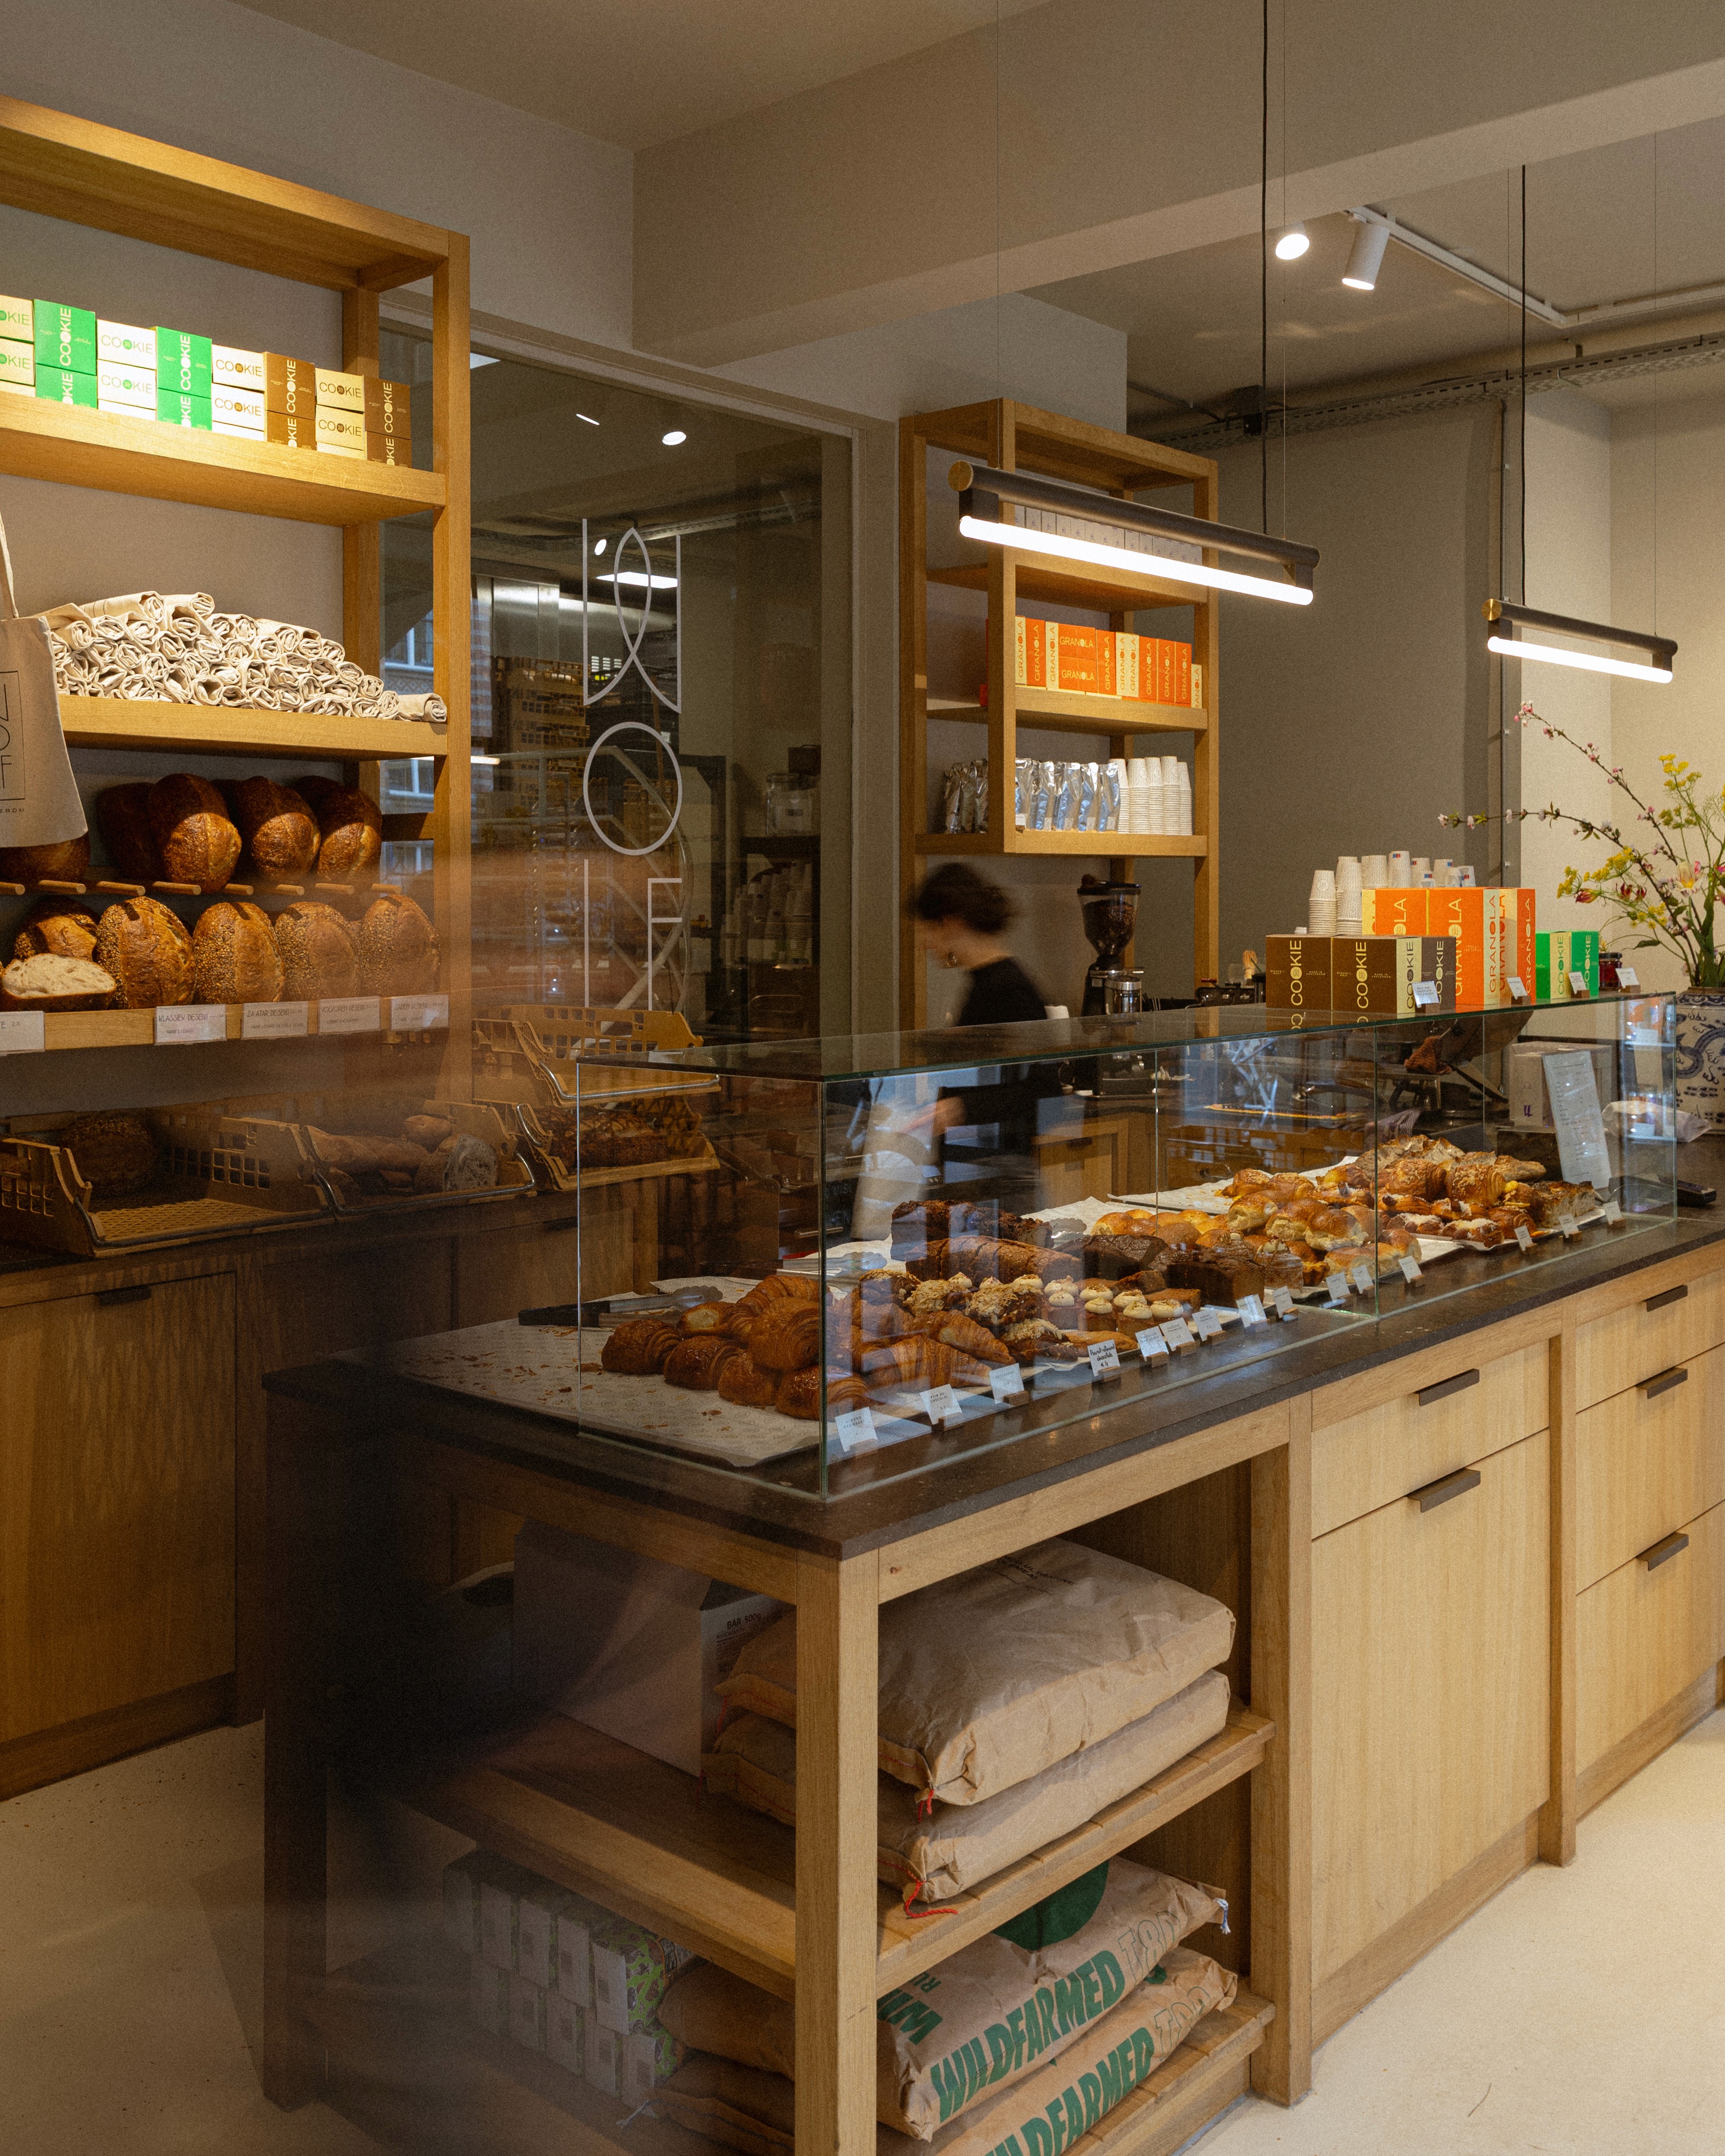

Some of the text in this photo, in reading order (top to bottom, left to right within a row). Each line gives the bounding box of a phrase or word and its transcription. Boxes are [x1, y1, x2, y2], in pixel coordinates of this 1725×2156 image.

[0, 310, 30, 326] OKIE
[60, 307, 71, 366] COOKIE
[101, 334, 154, 354] COOKIE
[0, 354, 30, 369] OKIE
[180, 334, 191, 391] COOKIE
[216, 359, 262, 377] COOKIE
[62, 372, 74, 405] OKIE
[101, 375, 153, 394] COOKIE
[286, 359, 296, 413] COOKIE
[319, 382, 361, 398] COOKIE
[181, 396, 191, 428] OKIE
[214, 398, 262, 416] COOKIE
[383, 382, 393, 434] COOKIE
[287, 418, 297, 448] OKIE
[318, 419, 361, 437] COOKIE
[386, 438, 395, 465] OKIE
[1059, 636, 1094, 649] GRANOLA
[1061, 669, 1095, 681] GRANOLA
[1290, 940, 1303, 1006] COOKIE
[1356, 942, 1369, 1009] COOKIE
[930, 1950, 1126, 2123] WILDFARMED
